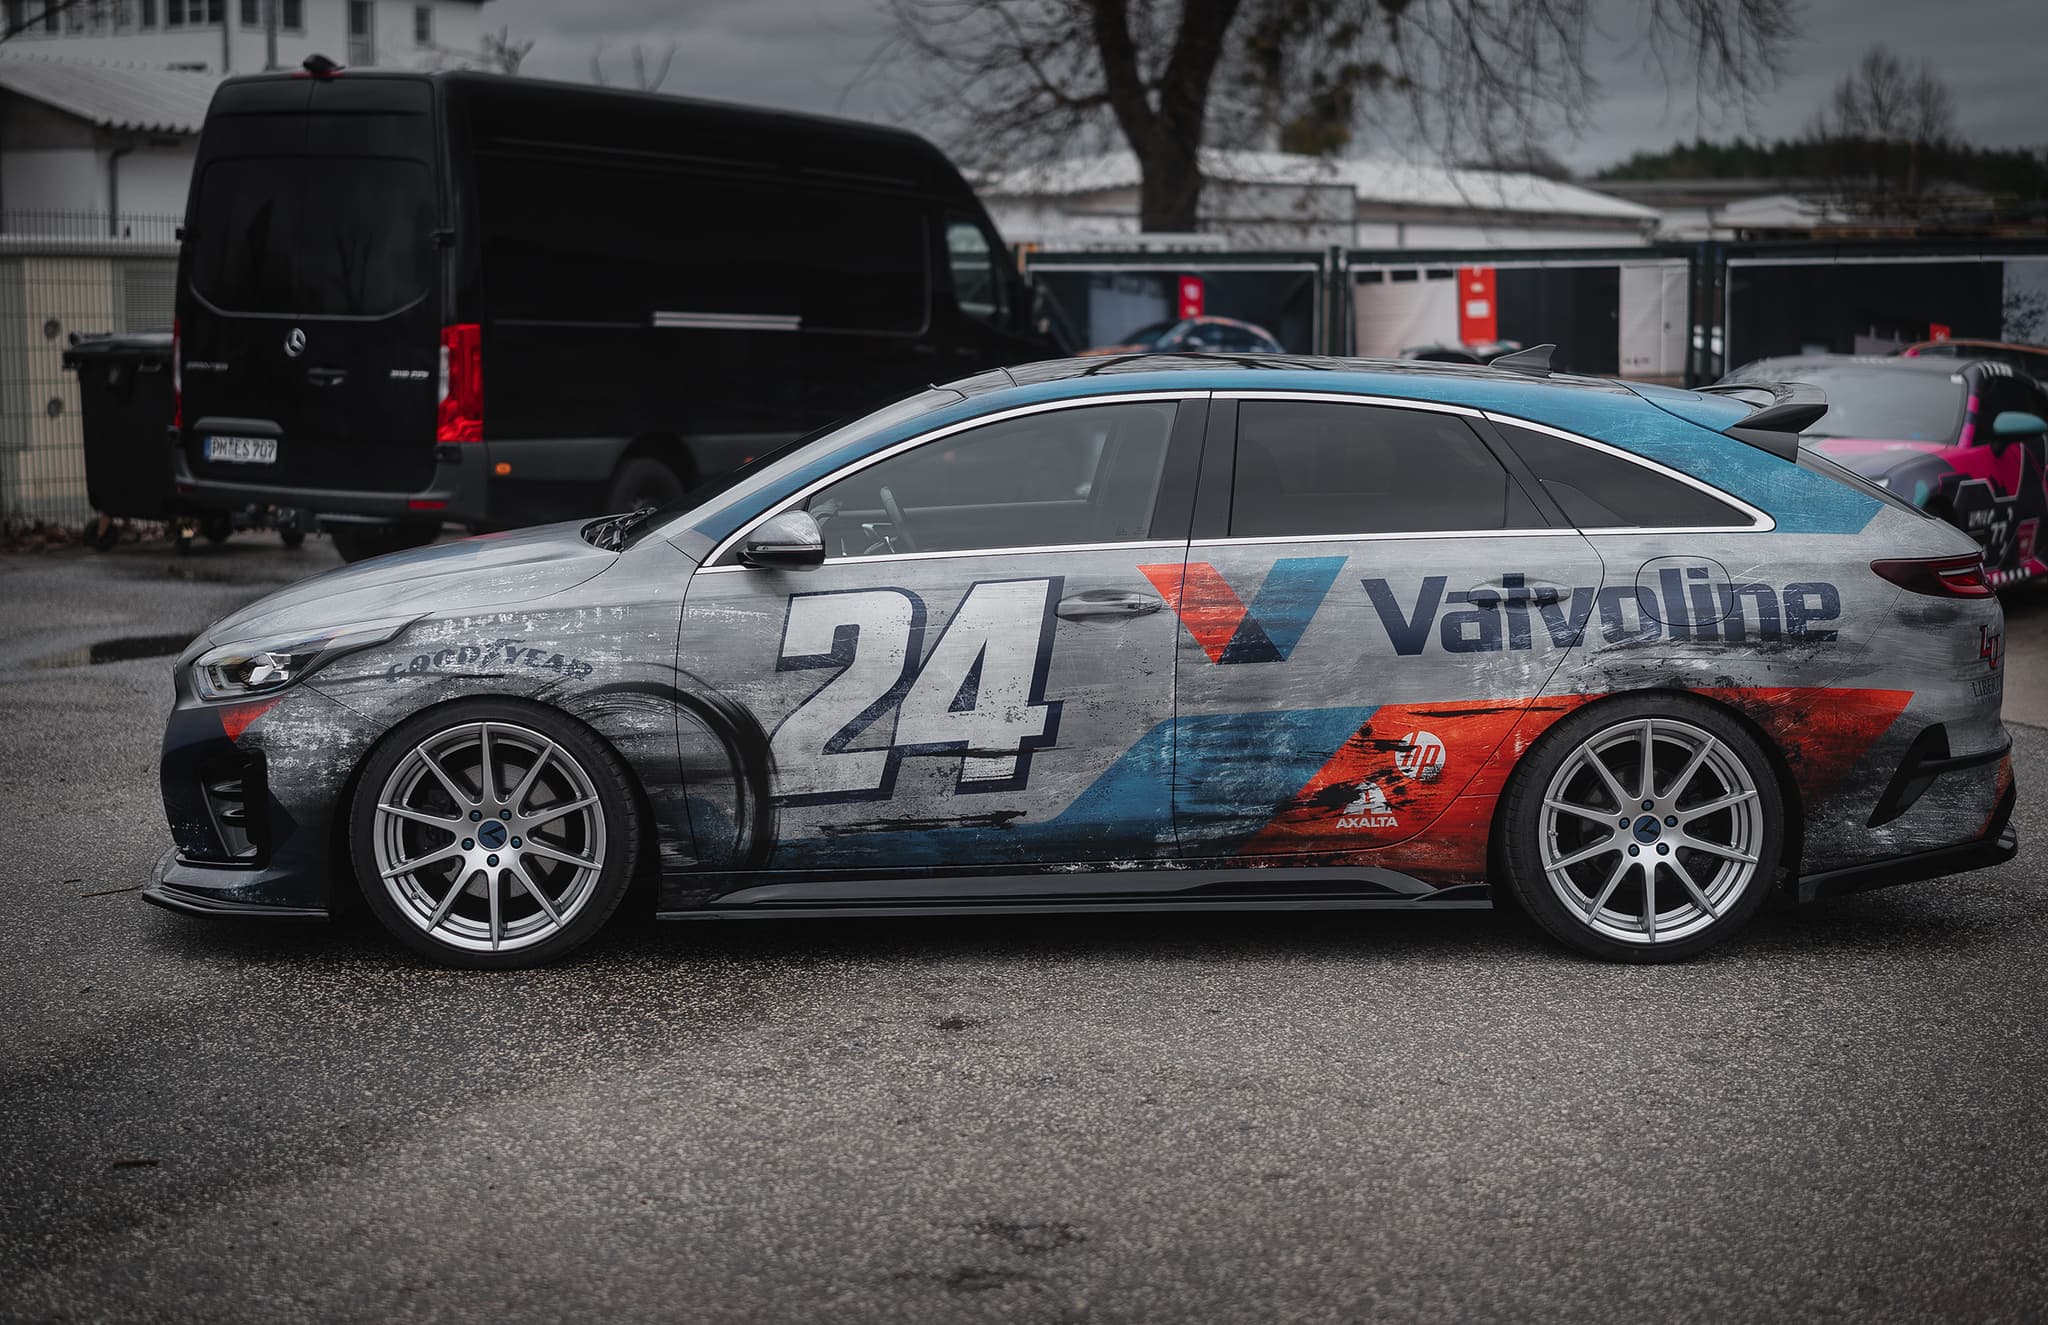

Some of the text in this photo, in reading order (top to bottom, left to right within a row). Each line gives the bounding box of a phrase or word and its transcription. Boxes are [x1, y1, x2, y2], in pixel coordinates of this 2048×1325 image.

[1361, 567, 1841, 656] Valvoline
[768, 575, 1064, 808] 24
[1336, 816, 1398, 829] AXALTA
